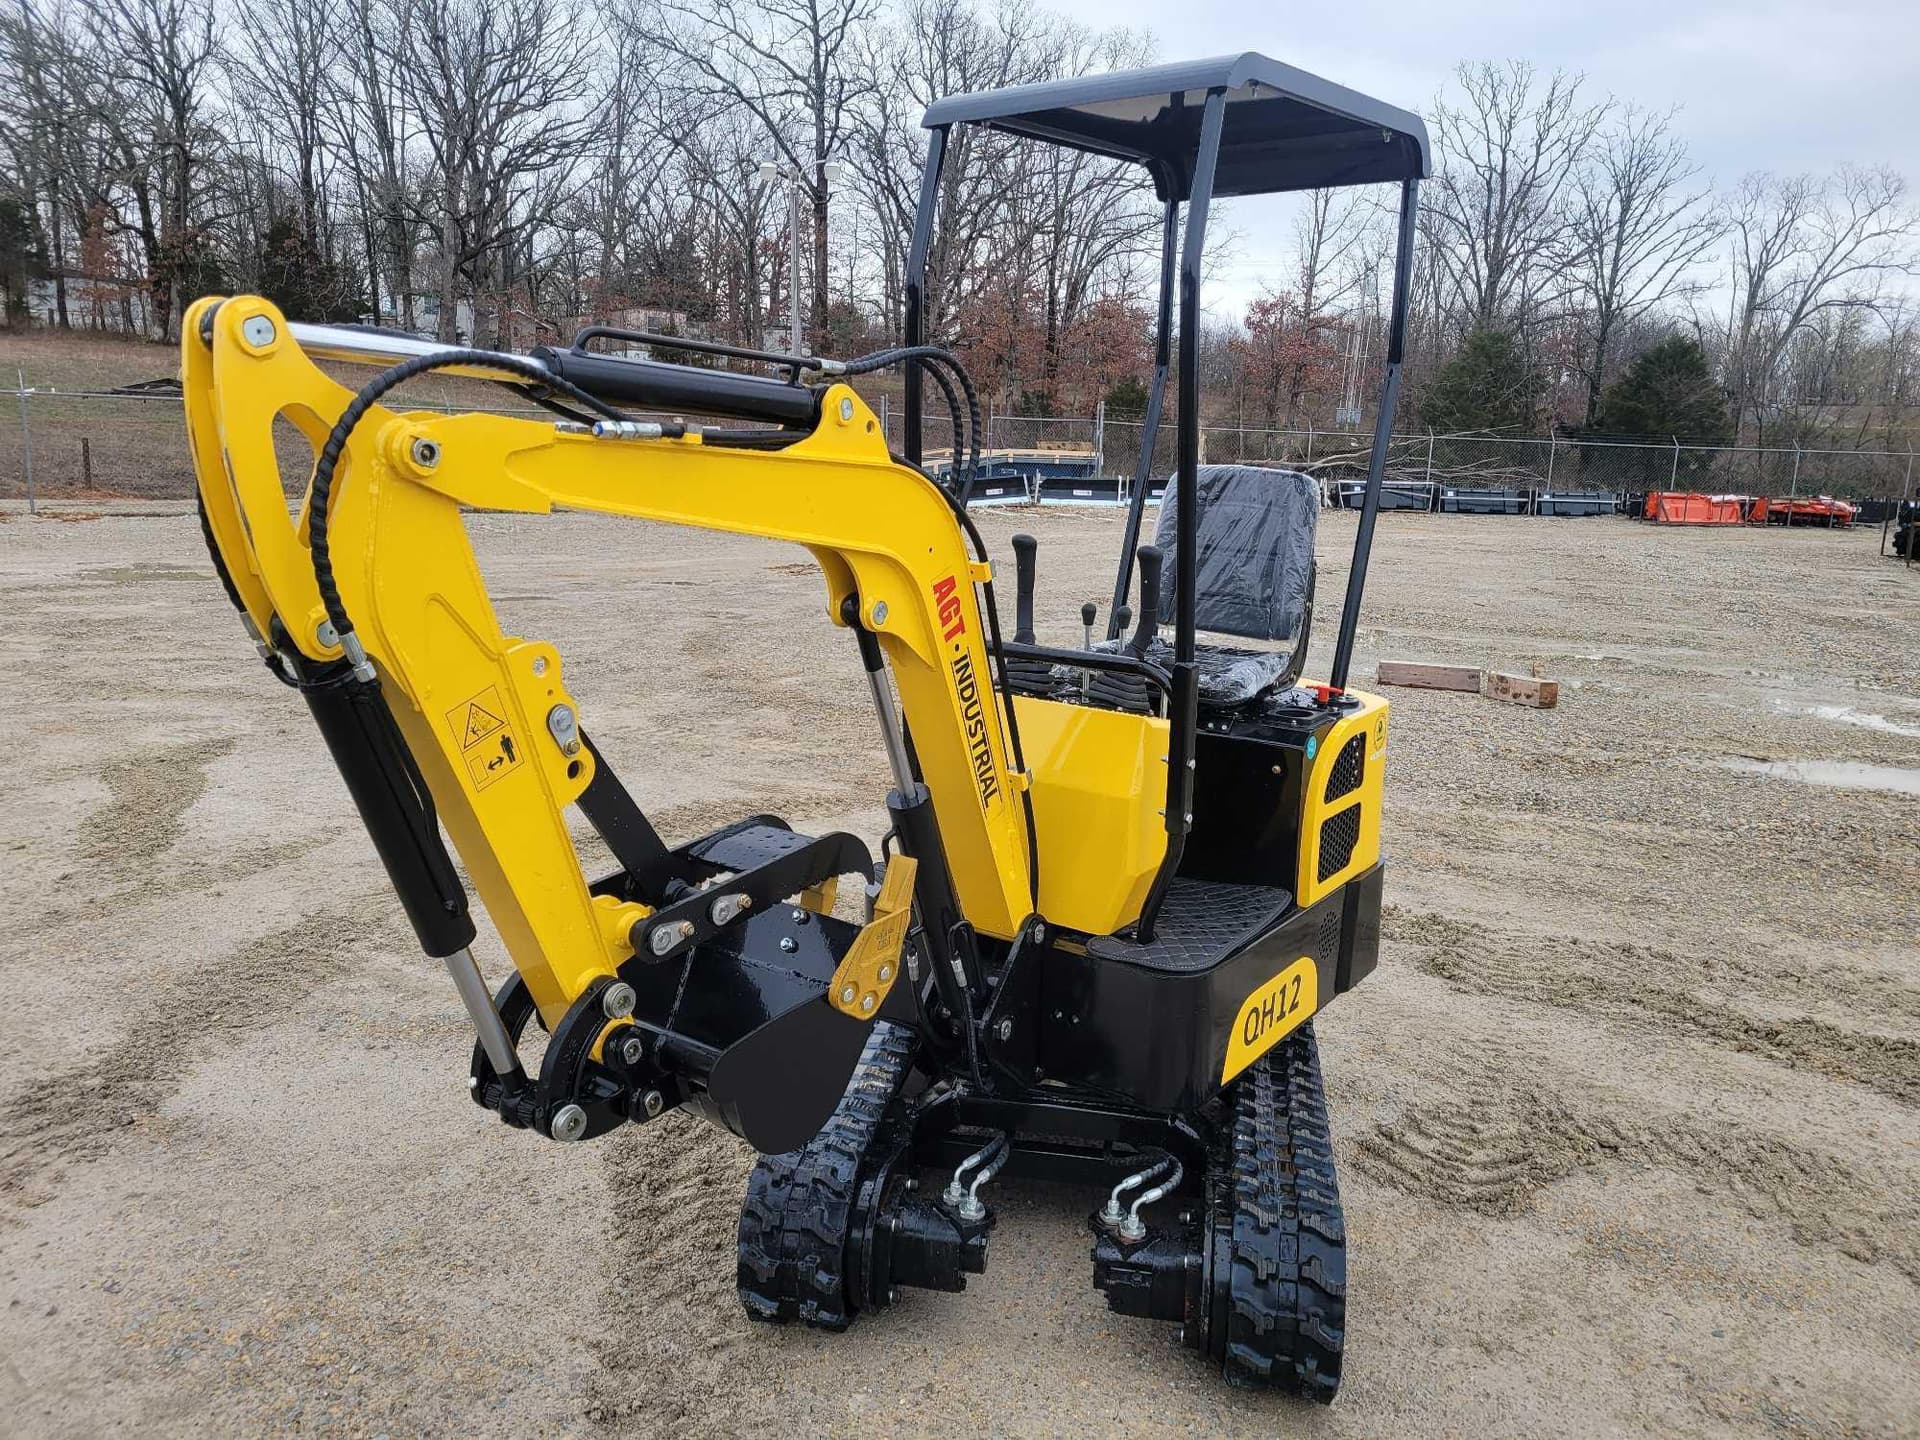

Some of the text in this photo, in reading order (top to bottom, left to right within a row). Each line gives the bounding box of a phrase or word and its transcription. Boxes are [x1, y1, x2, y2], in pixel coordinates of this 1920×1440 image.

[932, 575, 998, 808] AGT INDUSTRIAL
[1244, 974, 1302, 1046] QH12
